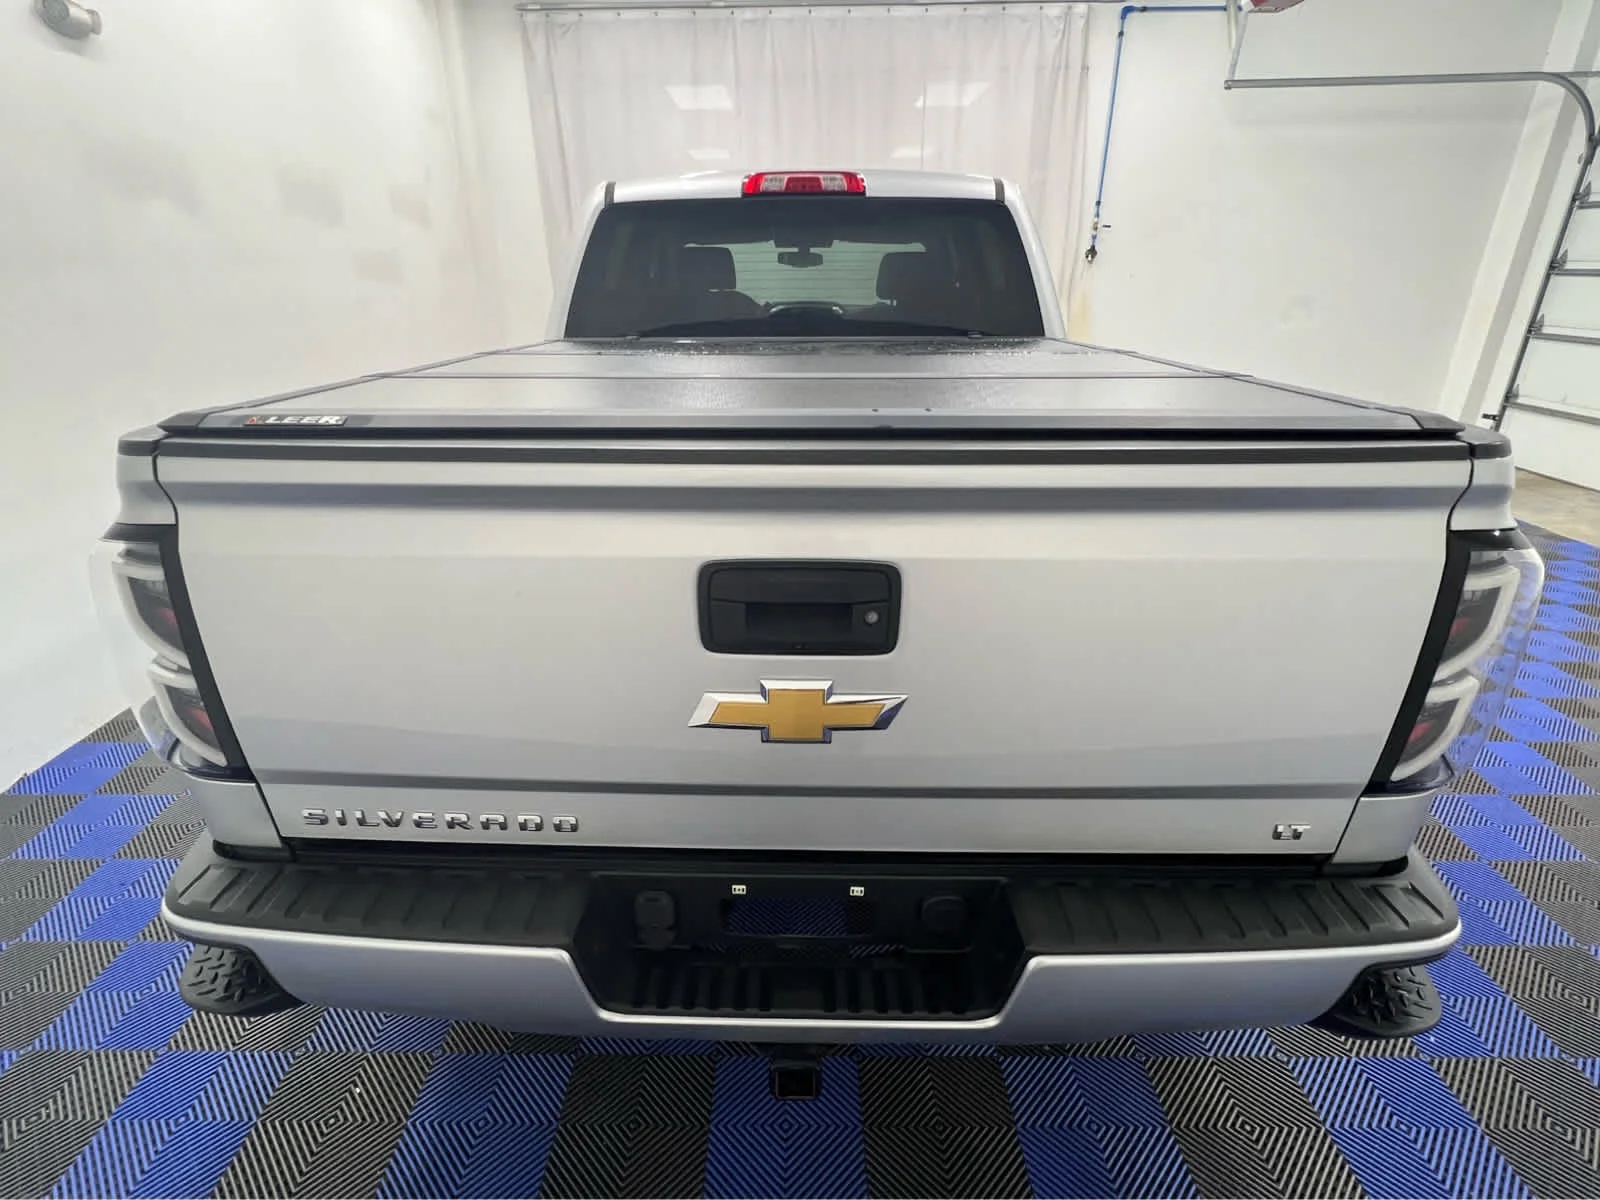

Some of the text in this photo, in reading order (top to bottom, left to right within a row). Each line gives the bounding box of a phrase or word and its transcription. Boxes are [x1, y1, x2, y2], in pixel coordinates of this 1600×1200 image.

[265, 415, 345, 425] LEER
[302, 808, 580, 833] SILVERADO
[1271, 823, 1312, 841] LT
